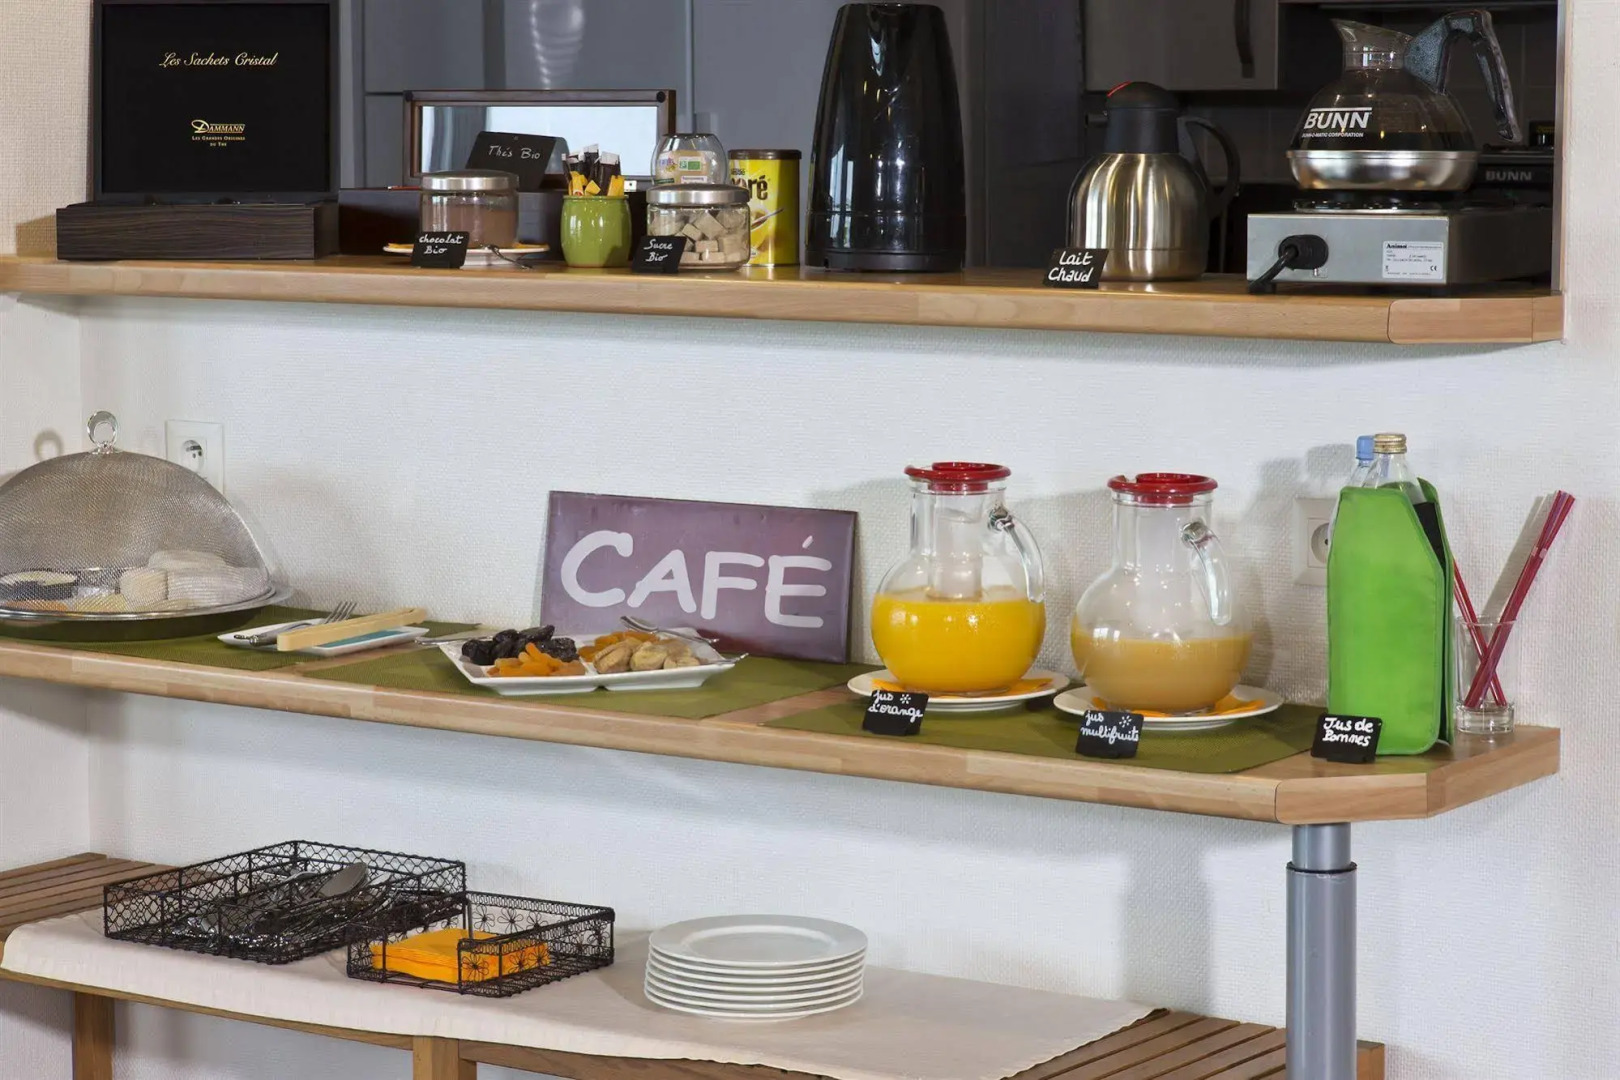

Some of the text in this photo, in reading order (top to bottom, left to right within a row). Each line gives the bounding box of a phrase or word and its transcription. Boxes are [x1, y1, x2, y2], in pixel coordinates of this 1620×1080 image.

[159, 52, 279, 68] Les Sachets Cristal
[191, 119, 246, 134] DAMMANN
[1303, 111, 1369, 130] BUNN
[1485, 170, 1532, 181] BUNN
[423, 245, 448, 255] Bio
[644, 238, 673, 250] Sucre
[645, 251, 668, 262] Bio
[1059, 251, 1093, 266] Lait
[1048, 267, 1094, 282] Chaud
[560, 529, 832, 628] CAFÉ
[1323, 717, 1374, 733] Jus de
[1322, 729, 1371, 747] Pommes
